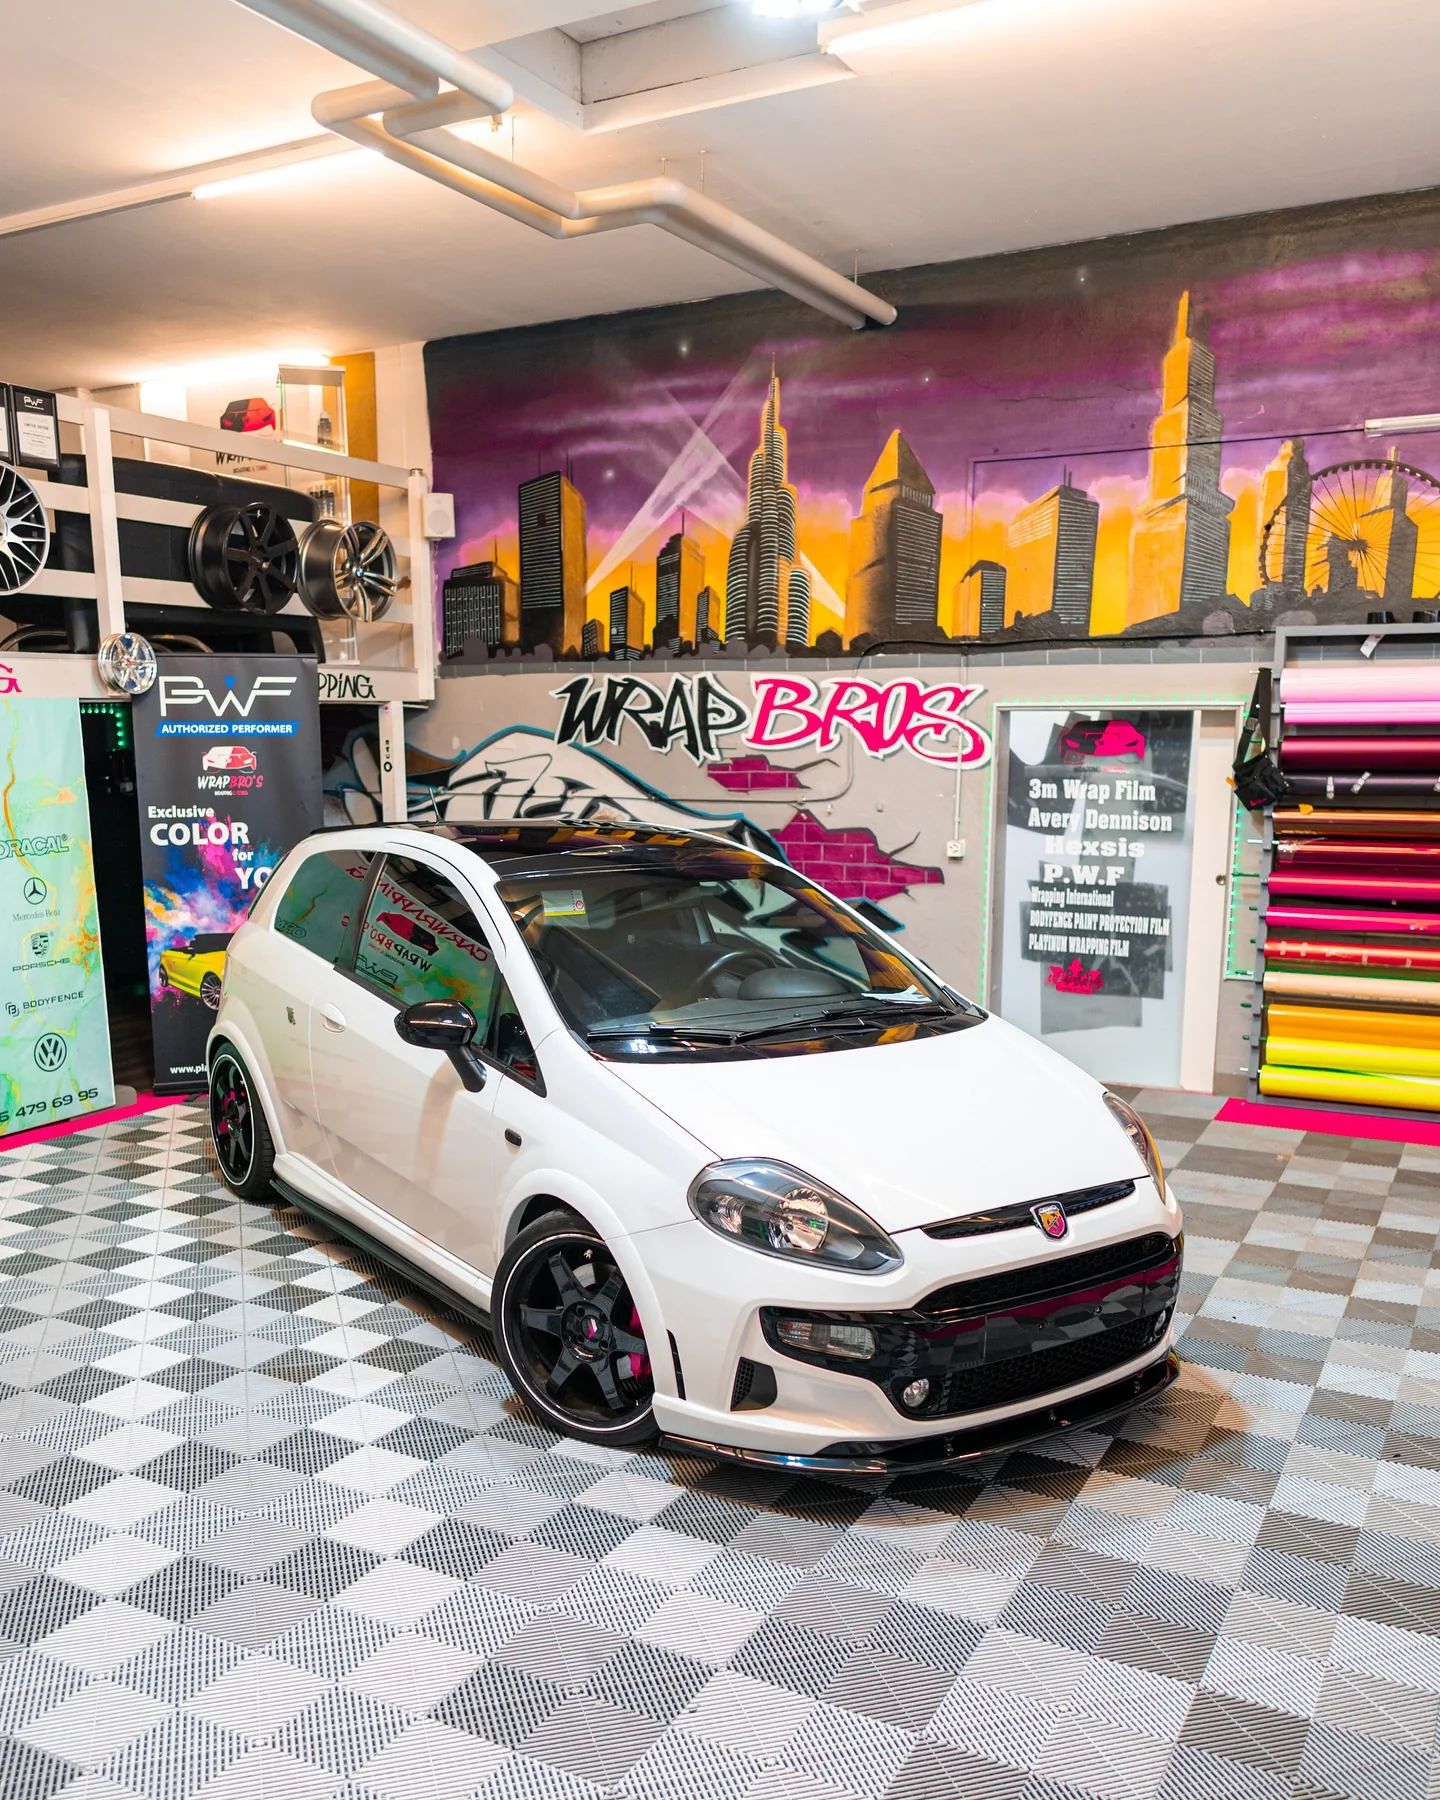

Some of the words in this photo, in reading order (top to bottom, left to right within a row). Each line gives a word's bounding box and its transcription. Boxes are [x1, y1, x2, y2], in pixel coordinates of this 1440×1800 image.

[158, 676, 298, 717] PWF
[161, 723, 229, 734] AUTHORIZED
[231, 723, 293, 734] PERFORMER
[551, 674, 749, 764] WRAP
[745, 676, 987, 764] BROS
[1029, 778, 1057, 799] 3m
[1063, 779, 1110, 804] Wrap
[1115, 779, 1156, 801] Film
[148, 804, 215, 819] Exclusive
[1028, 807, 1081, 833] Avery
[1085, 808, 1172, 832] Dennison
[149, 821, 250, 847] COLOR
[232, 849, 254, 861] for
[1044, 836, 1145, 858] Hexsis
[1043, 863, 1125, 886] P.W.F
[1031, 886, 1065, 908] Wrapping
[1066, 887, 1114, 907] International
[1030, 909, 1073, 929] BODYFENCE
[1074, 912, 1099, 931] PAINT
[1099, 913, 1149, 934] PROTECTION
[1149, 917, 1170, 936] FILM
[1028, 933, 1068, 952] PLATINUM
[1068, 935, 1109, 956] WRAPPING
[1109, 939, 1130, 958] FILM
[12, 957, 70, 972] PORSCHE
[23, 990, 85, 1010] BODYFENCE
[15, 1101, 47, 1118] 479
[51, 1094, 73, 1109] 69
[78, 1087, 98, 1101] 95
